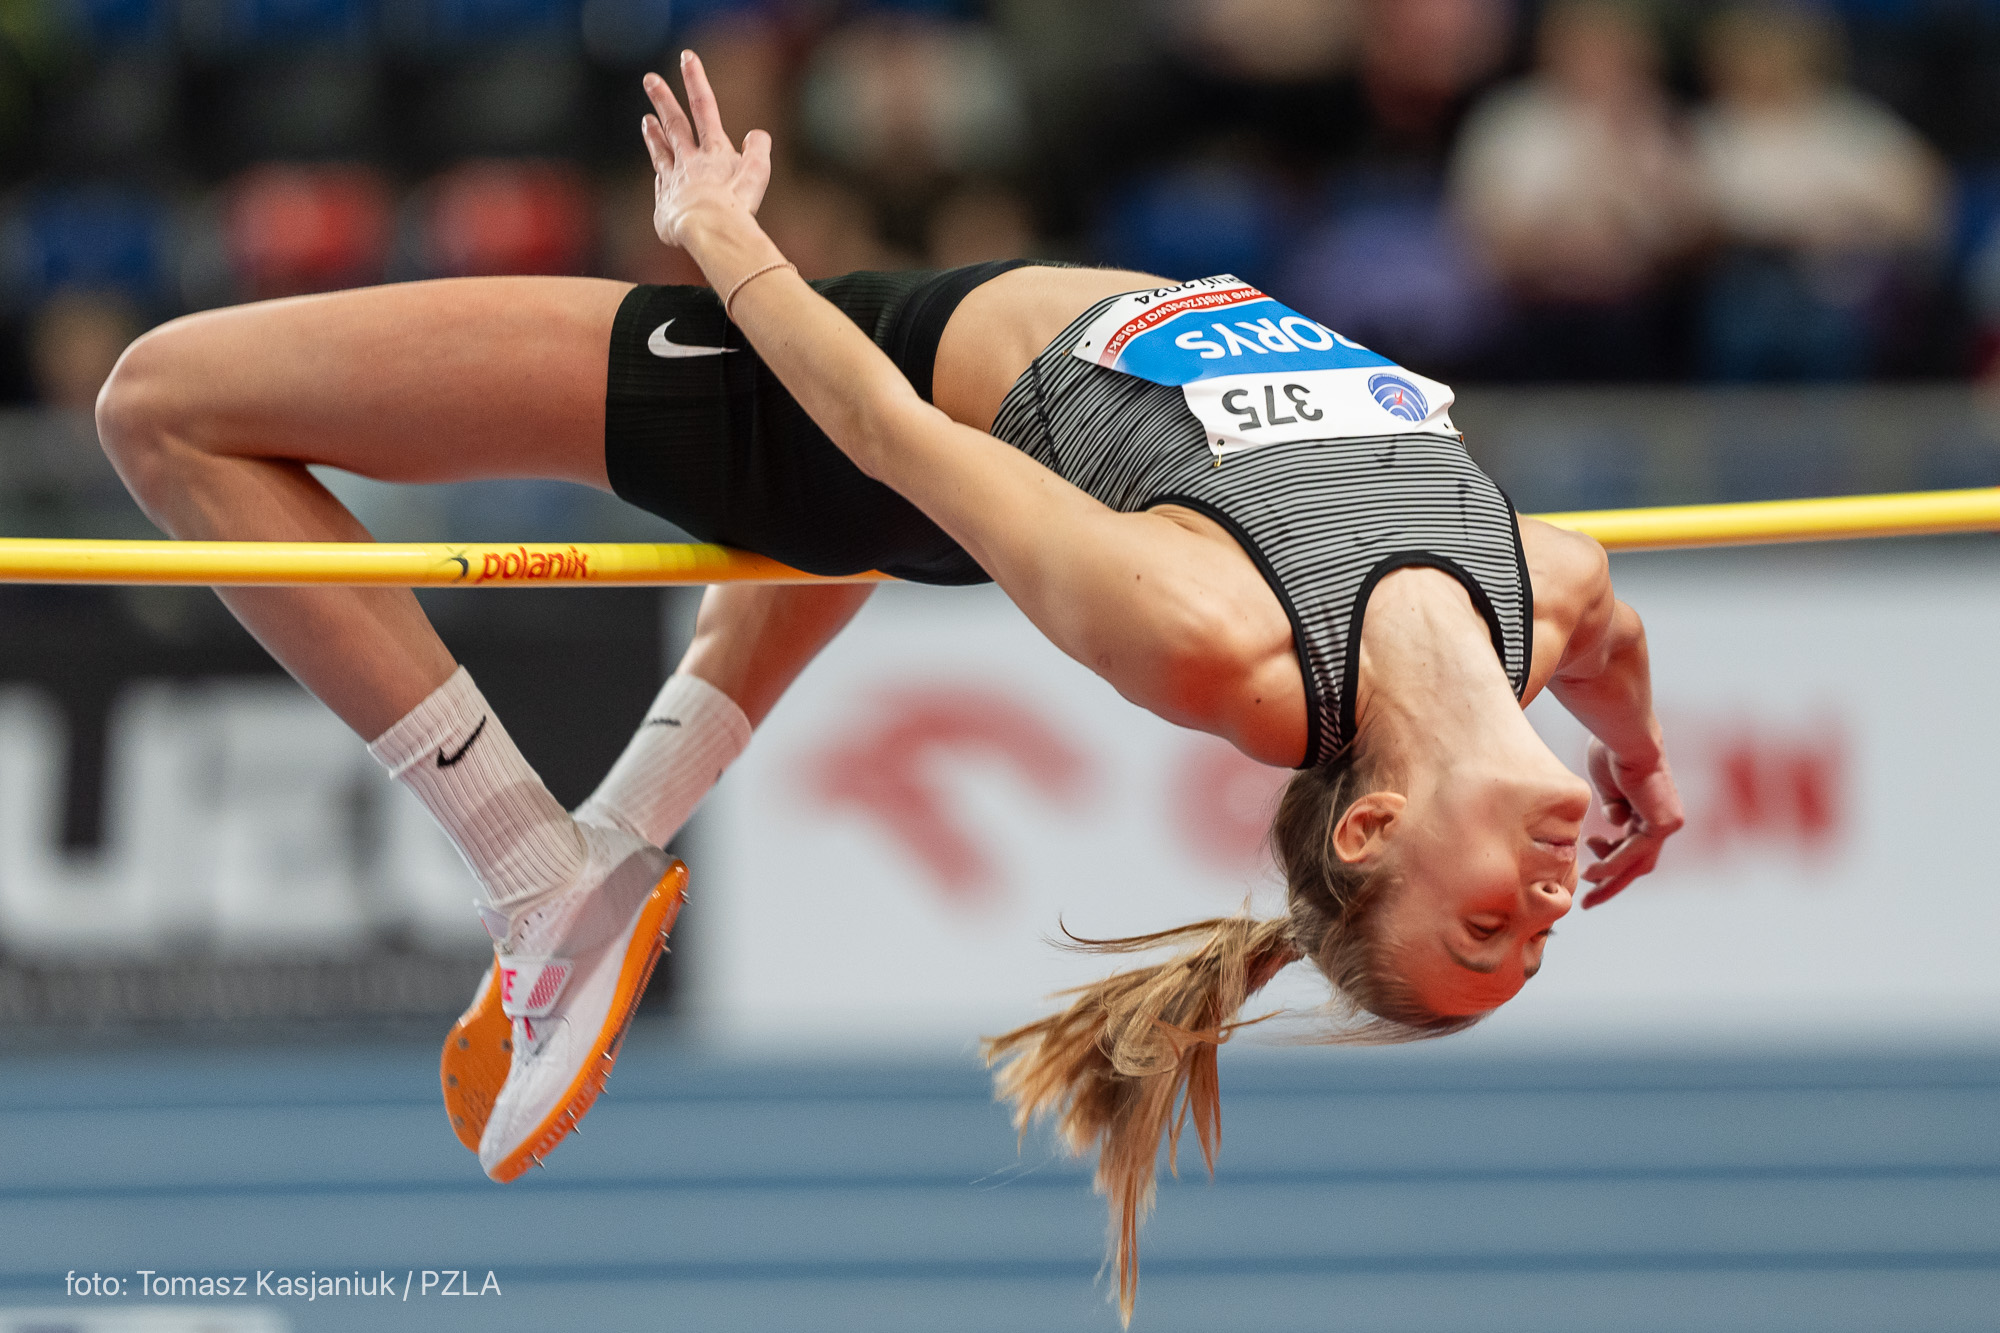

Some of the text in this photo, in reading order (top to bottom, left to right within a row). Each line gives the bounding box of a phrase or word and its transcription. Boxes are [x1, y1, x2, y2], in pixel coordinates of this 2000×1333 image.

[1145, 293, 1233, 323] Mistrzostwa
[1107, 319, 1148, 356] Polski
[1221, 383, 1324, 432] 375
[474, 545, 589, 585] polanik
